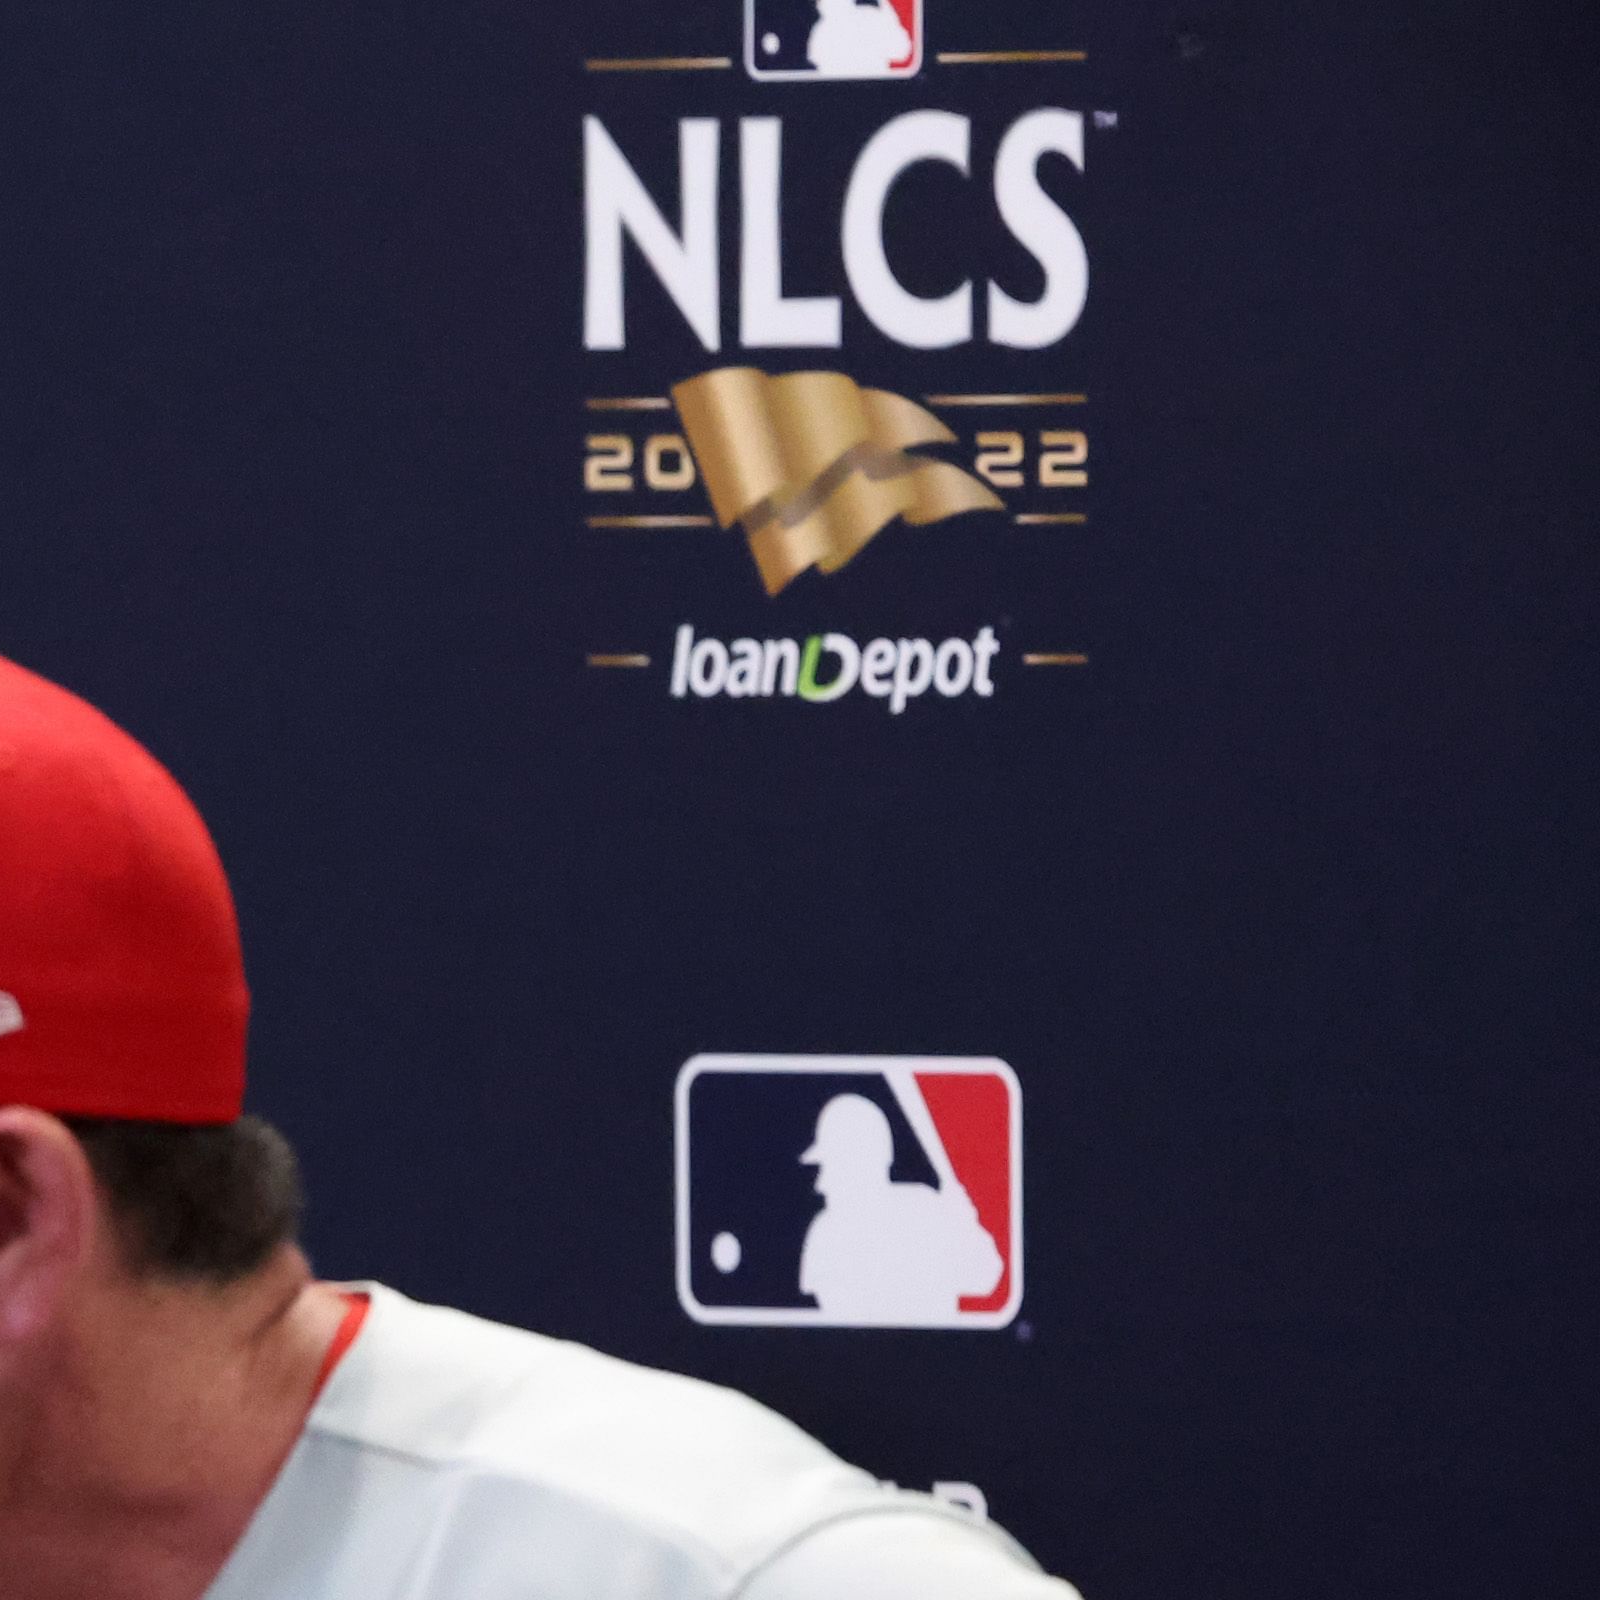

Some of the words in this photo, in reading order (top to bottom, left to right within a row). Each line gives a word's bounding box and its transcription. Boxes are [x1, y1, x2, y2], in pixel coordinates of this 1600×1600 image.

[583, 108, 1089, 352] NLCS
[585, 434, 696, 491] 20
[976, 431, 1088, 487] 22
[670, 624, 1000, 714] loanDepot
